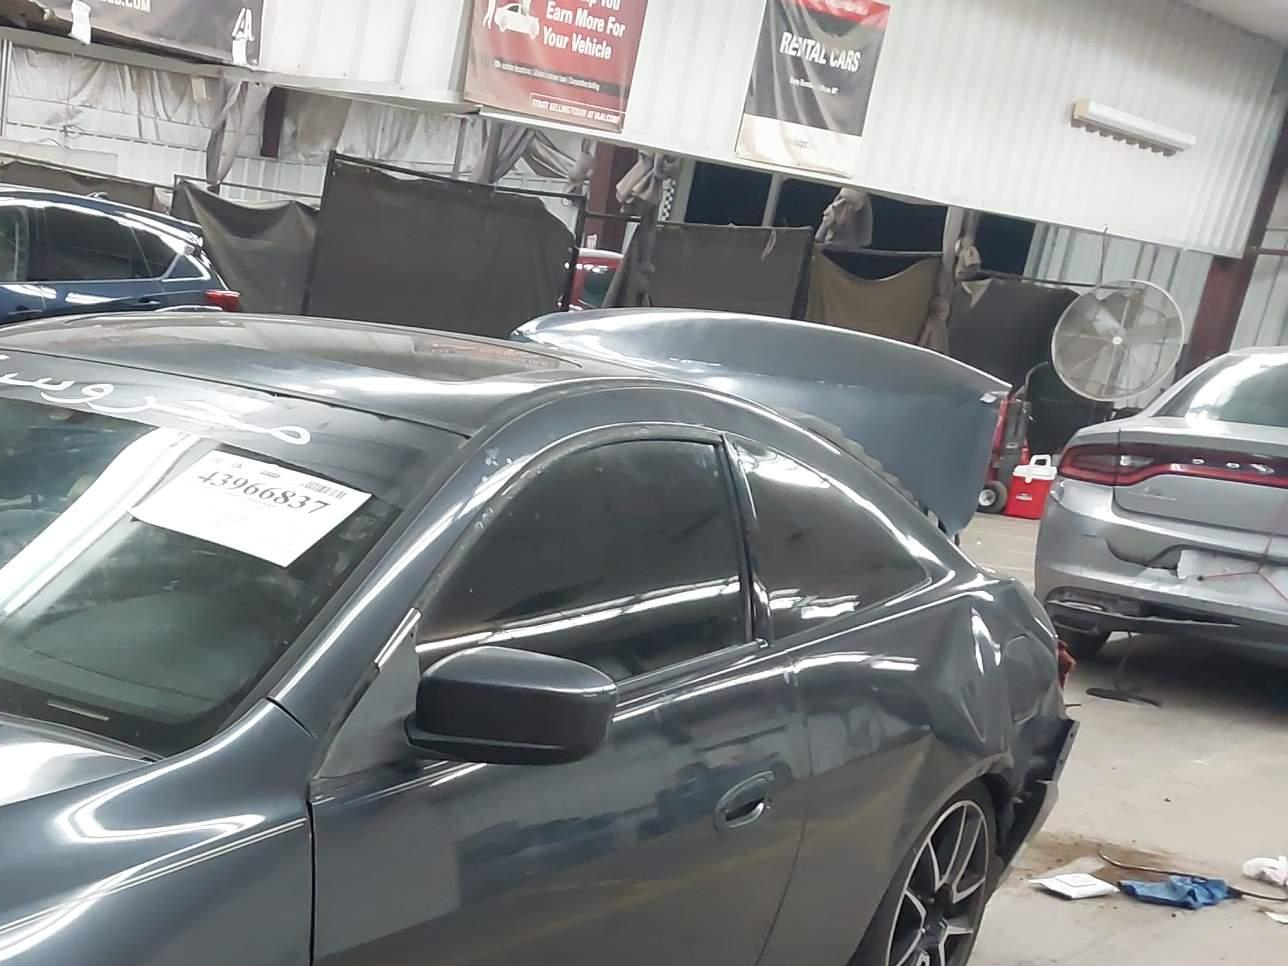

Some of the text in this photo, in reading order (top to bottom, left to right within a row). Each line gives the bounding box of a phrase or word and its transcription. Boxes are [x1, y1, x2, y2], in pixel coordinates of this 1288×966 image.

[546, 0, 626, 37] Earn More For
[543, 26, 612, 59] Your Vehicle
[779, 31, 861, 72] RENTAL CARS
[197, 470, 332, 514] 43966837
